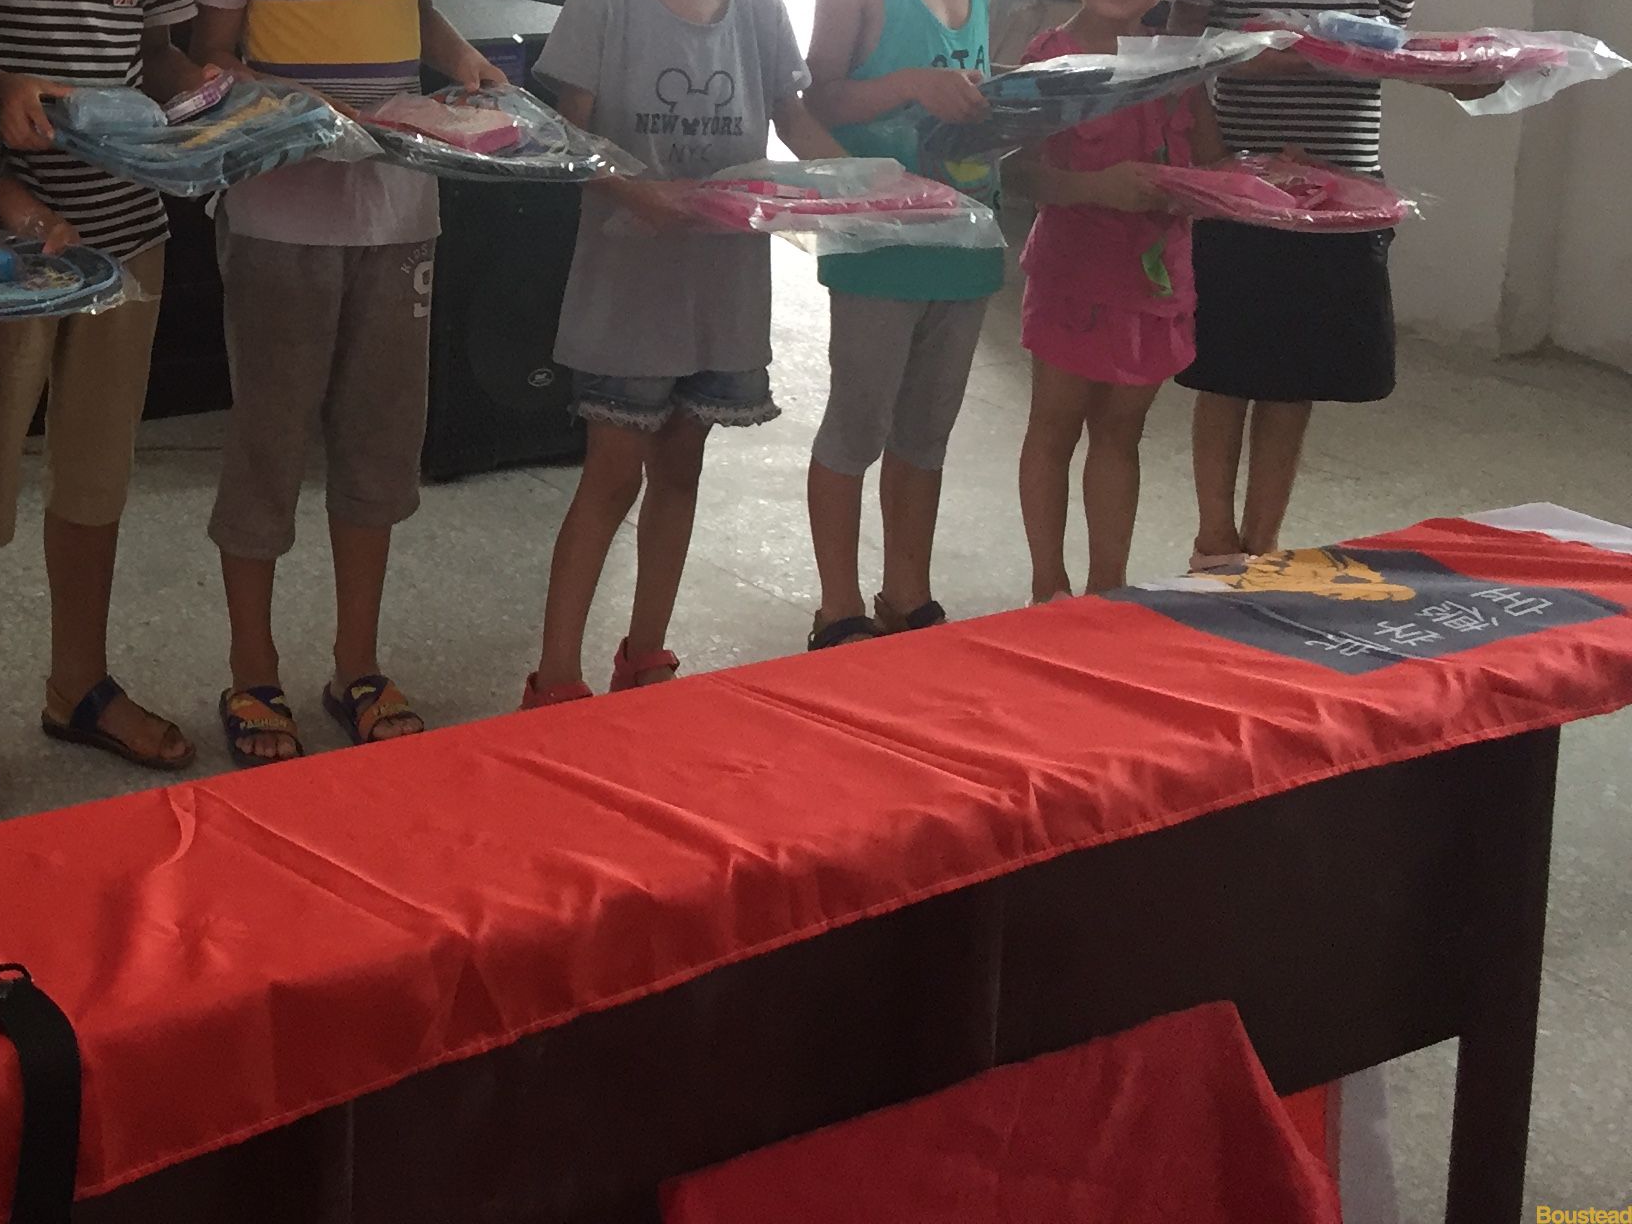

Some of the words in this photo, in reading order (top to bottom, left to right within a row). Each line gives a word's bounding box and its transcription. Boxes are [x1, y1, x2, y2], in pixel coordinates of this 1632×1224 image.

[634, 112, 679, 135] NEW
[701, 115, 744, 136] YORK
[669, 142, 713, 164] NYC
